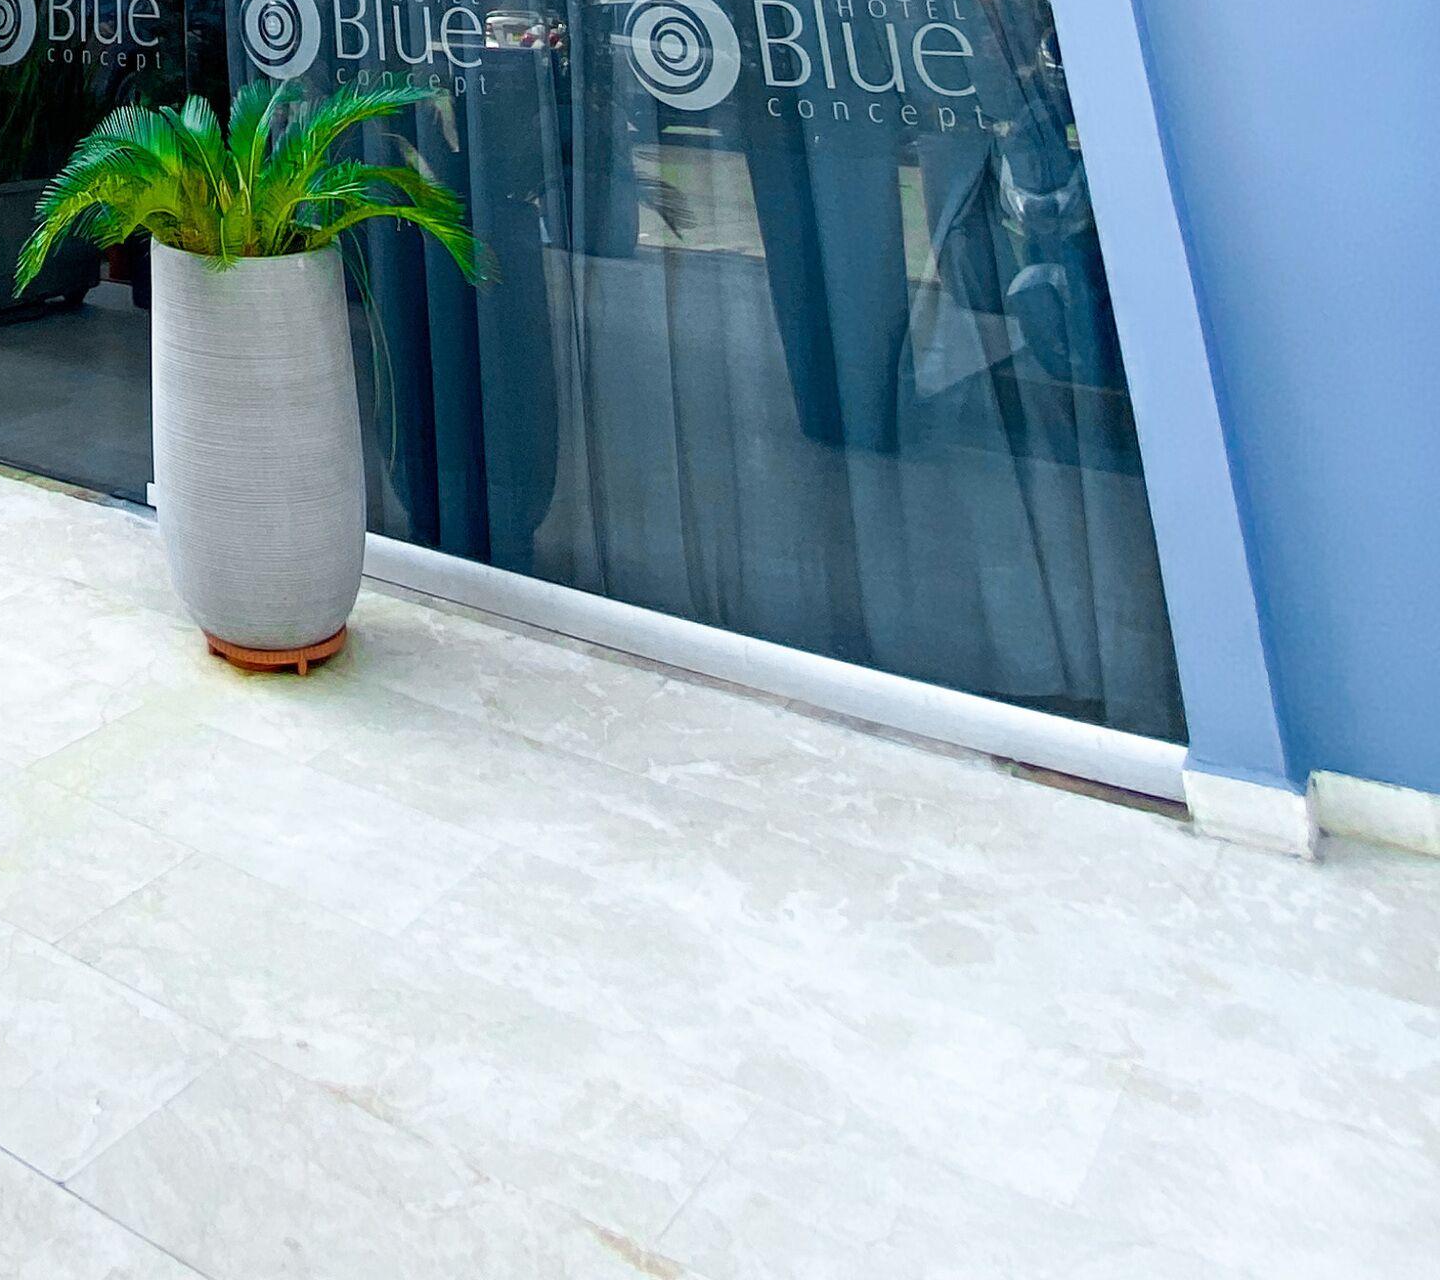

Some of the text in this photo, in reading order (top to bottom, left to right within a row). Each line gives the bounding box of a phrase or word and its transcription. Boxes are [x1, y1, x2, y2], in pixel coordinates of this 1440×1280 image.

[47, 47, 161, 71] concept
[336, 68, 487, 97] concept
[767, 97, 987, 132] concept
